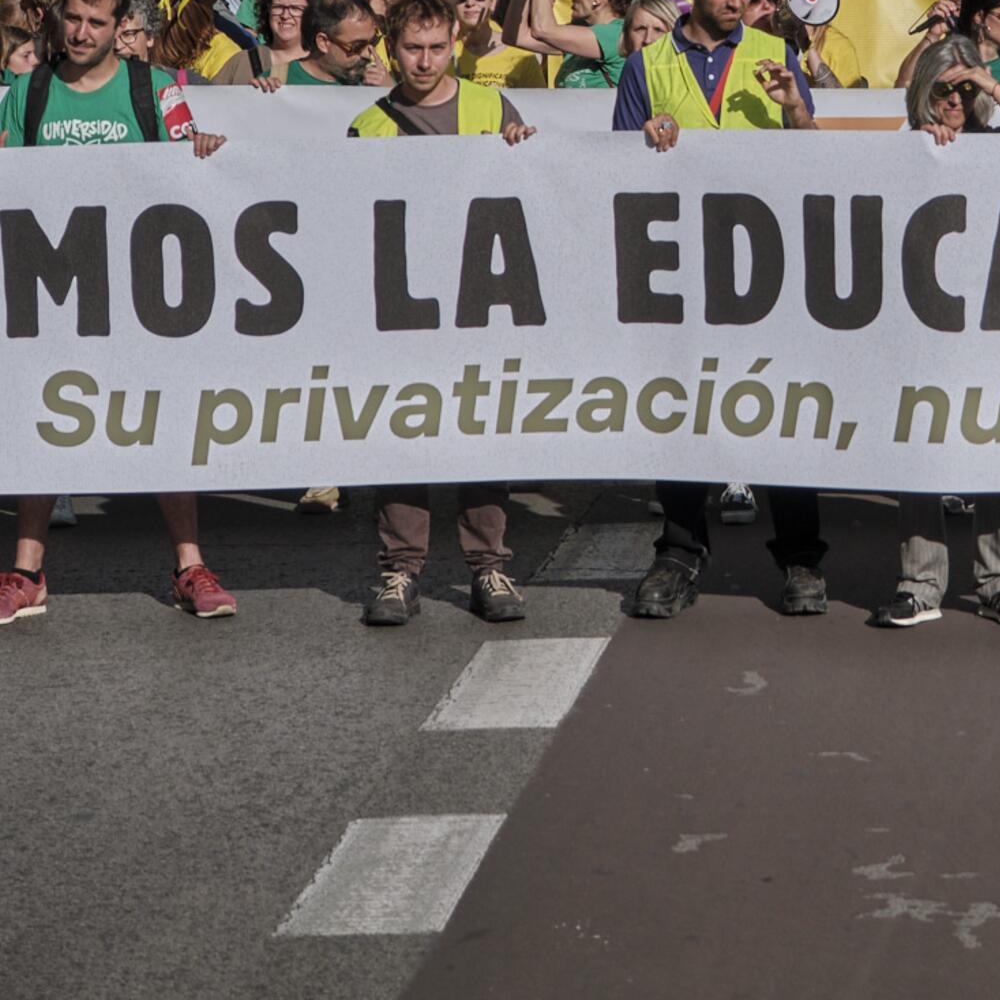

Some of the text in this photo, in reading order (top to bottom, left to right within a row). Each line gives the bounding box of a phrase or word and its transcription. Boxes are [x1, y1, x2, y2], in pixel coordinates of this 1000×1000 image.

[42, 118, 129, 142] UNIVERSIDAD
[373, 196, 547, 333] LA
[36, 370, 159, 448] Su
[191, 357, 858, 466] privatización,
